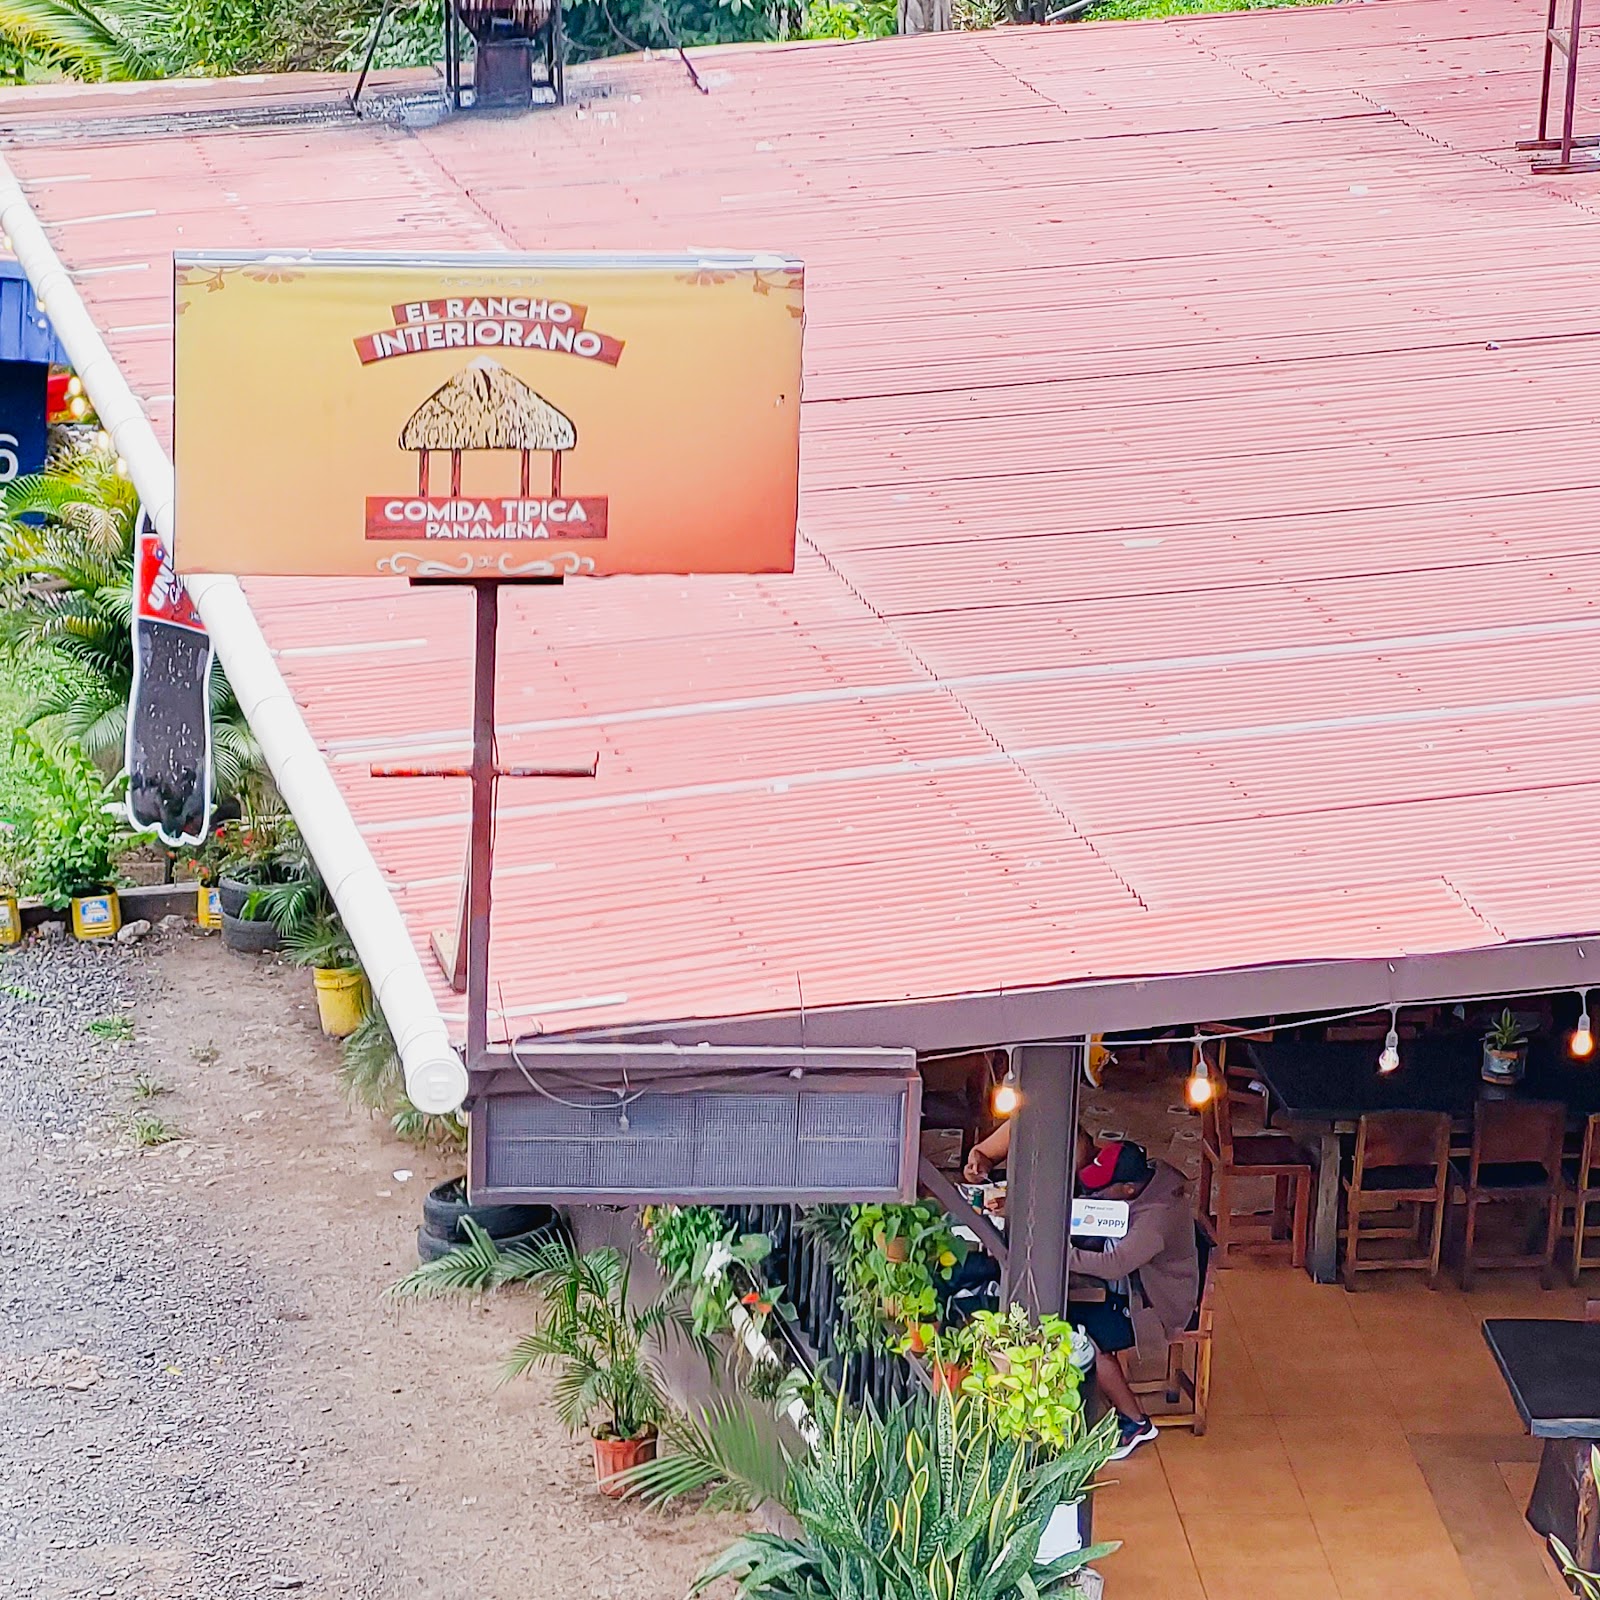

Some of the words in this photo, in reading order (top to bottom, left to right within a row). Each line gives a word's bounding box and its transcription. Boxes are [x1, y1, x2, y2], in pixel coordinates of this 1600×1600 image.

[405, 302, 439, 323] EL
[446, 297, 572, 323] RANCHO
[372, 320, 602, 357] INTERIORANO
[384, 500, 493, 522] COMIDA
[501, 499, 587, 522] TIPICA
[1097, 1218, 1126, 1228] yappy
